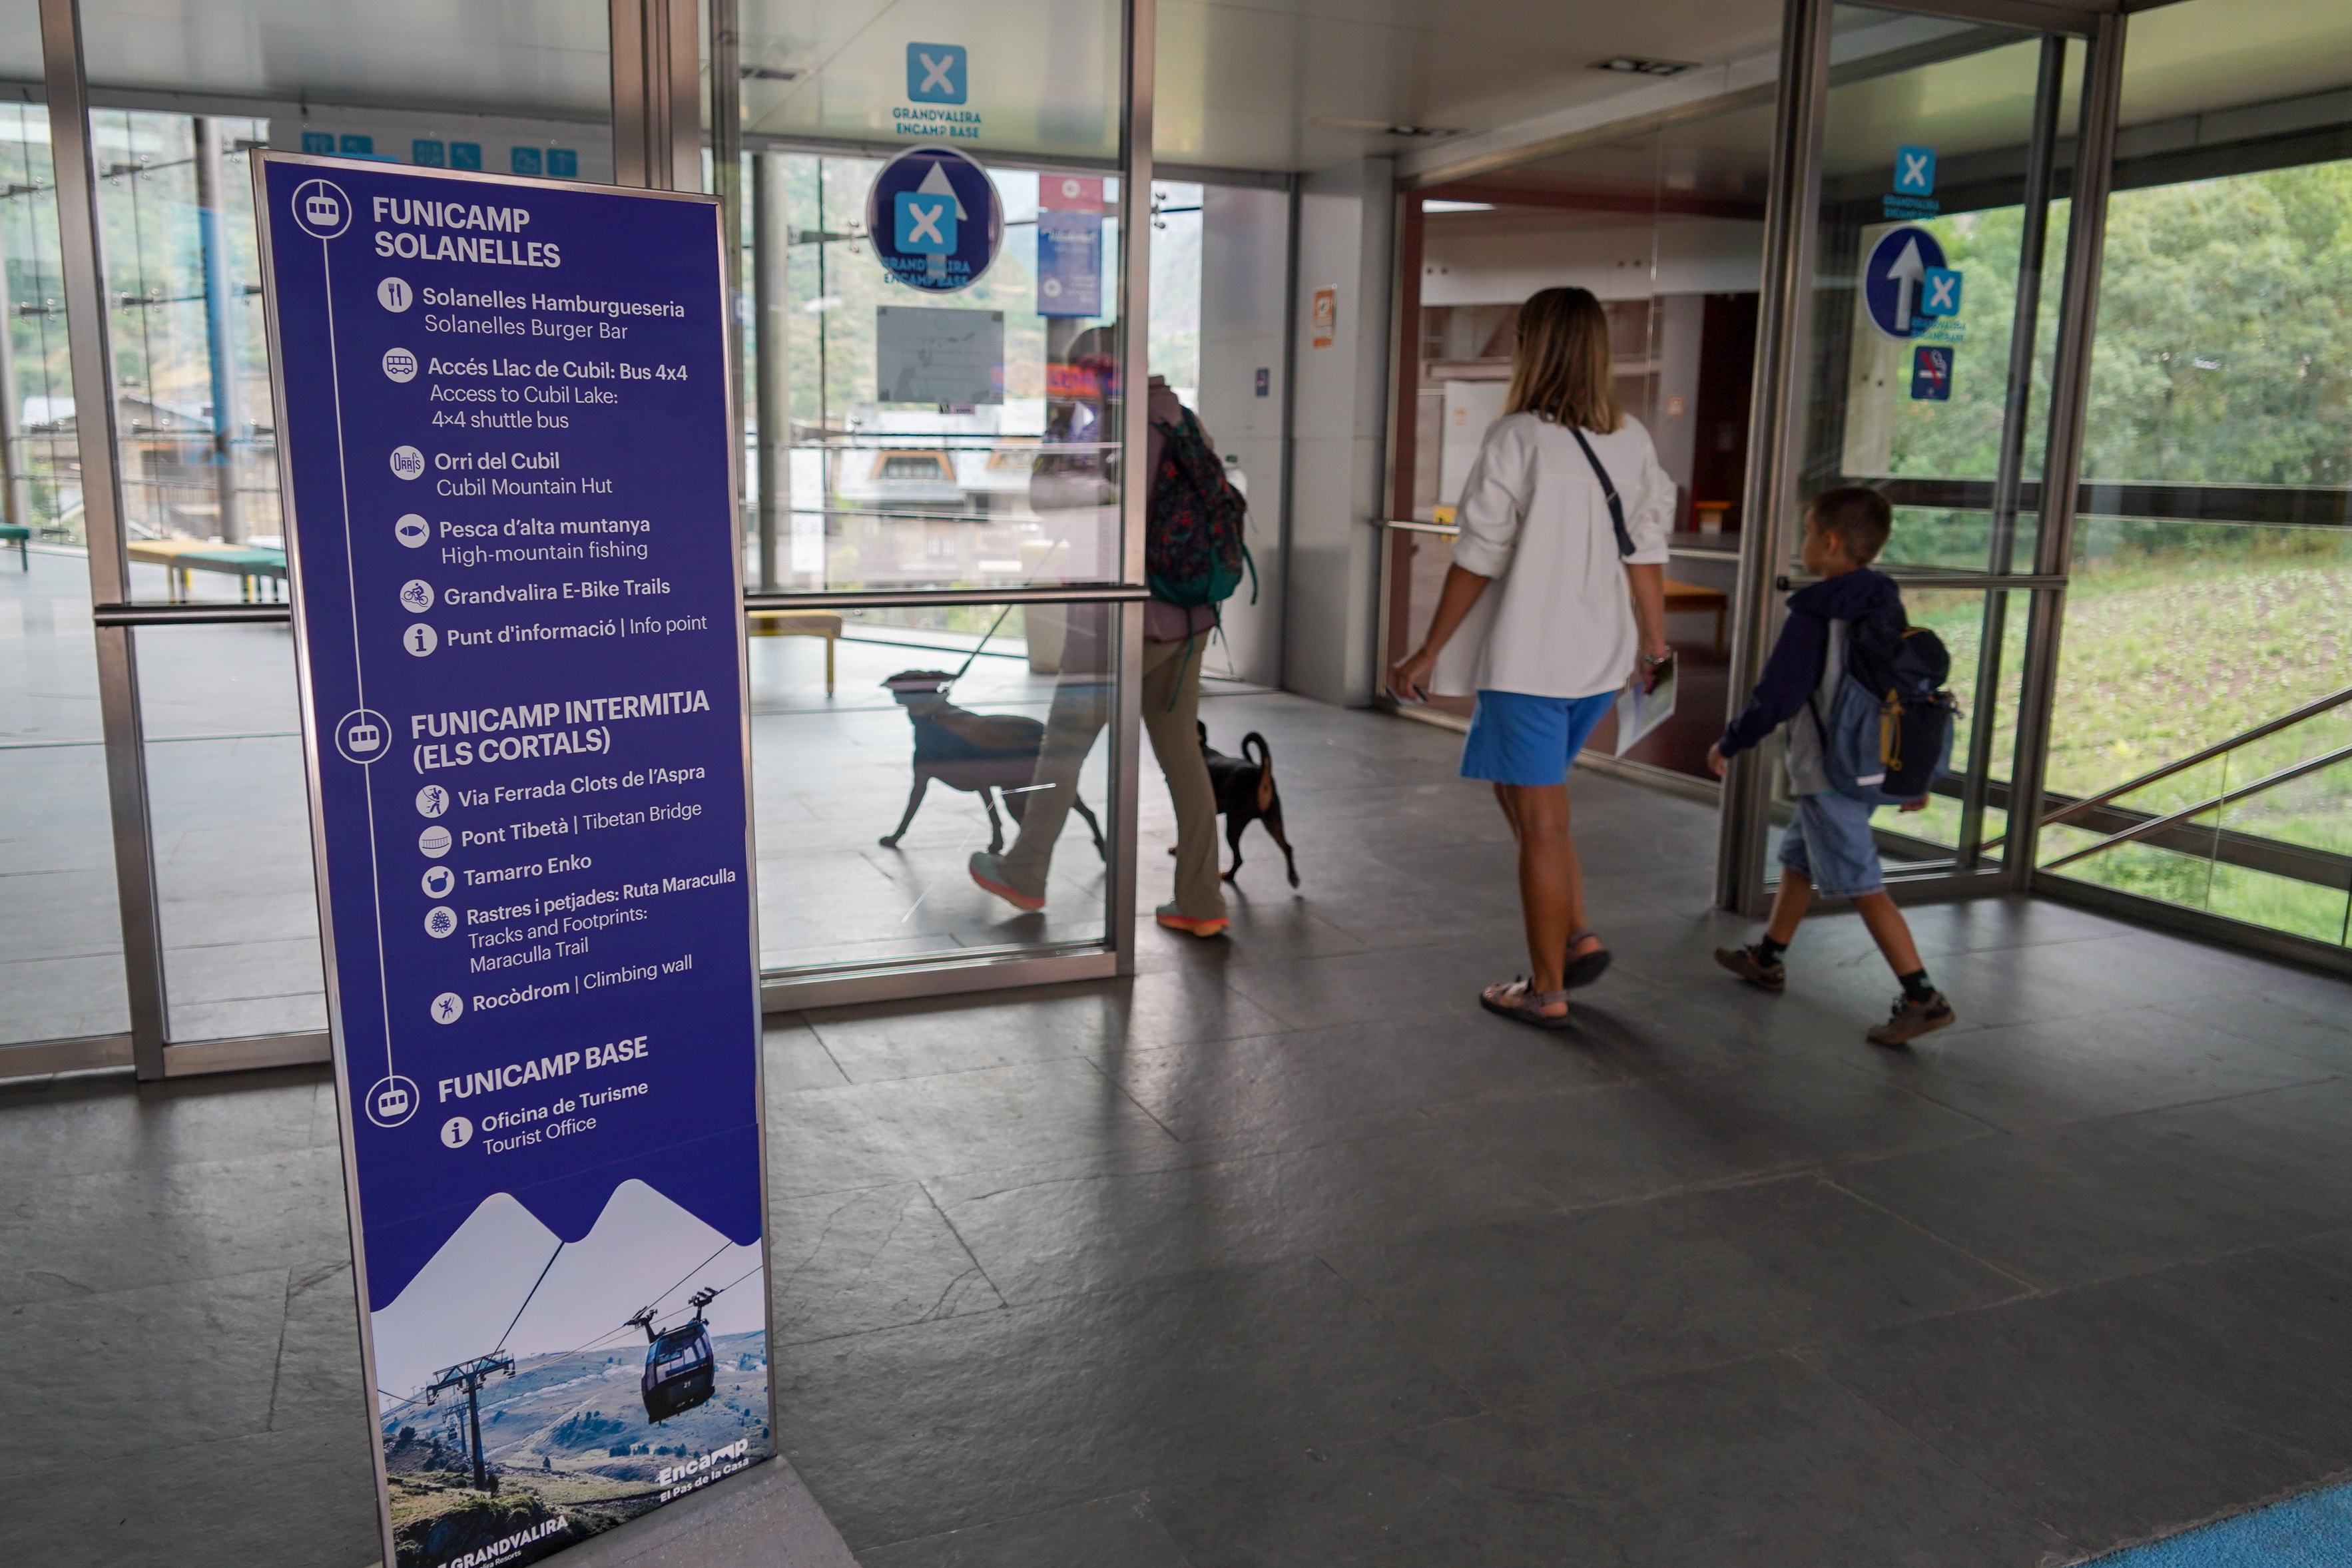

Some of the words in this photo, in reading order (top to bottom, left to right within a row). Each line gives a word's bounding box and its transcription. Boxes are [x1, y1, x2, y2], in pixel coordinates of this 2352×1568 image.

[892, 107, 982, 123] GRANDVALIRA
[896, 123, 946, 136] ENCAMP
[950, 125, 979, 138] BASE
[373, 196, 530, 233] FUNICAMP
[375, 230, 561, 268] SOLANELLES
[423, 287, 527, 310] Solanelles
[531, 293, 685, 318] Hamburgueseria
[425, 314, 525, 336] Solanelles
[531, 318, 593, 341] Burger
[599, 322, 628, 339] Bar
[428, 357, 488, 376] Accés
[492, 358, 531, 377] Llac
[535, 359, 559, 378] de
[563, 361, 615, 379] Cubil:
[619, 363, 652, 380] Bus
[655, 364, 689, 381] 4x4
[430, 384, 497, 402] Access
[500, 387, 519, 403] to
[523, 385, 570, 403] Cubil
[575, 386, 618, 404] Lake:
[471, 409, 533, 428] shuttle
[537, 410, 569, 429] bus
[434, 452, 473, 470] Orri
[477, 451, 507, 470] del
[511, 451, 560, 469] Cubil
[436, 477, 486, 497] Cubil
[491, 478, 577, 495] Mountain
[581, 477, 613, 493] Hut
[440, 521, 498, 539] Pesca
[560, 518, 651, 536] muntanya
[441, 545, 583, 567] High-mountain
[588, 540, 648, 560] fishing
[444, 583, 557, 605] Grandvalira
[563, 580, 619, 599] E-Bike
[623, 577, 671, 596] Trails
[447, 629, 493, 647] Punt
[497, 619, 616, 643] d'informació
[630, 616, 662, 635] Info
[666, 615, 708, 636] point
[411, 702, 560, 739] FUNICAMP
[565, 689, 711, 724] INTERMITJA
[413, 741, 473, 775] (ELS
[478, 726, 611, 763] CORTALS)
[457, 789, 489, 807] Via
[494, 779, 566, 804] Ferrada
[570, 776, 618, 794] Clots
[621, 770, 645, 788] de
[461, 828, 506, 847] Pont
[509, 817, 569, 840] Tibetà
[582, 811, 645, 830] Tibetan
[649, 802, 702, 822] Bridge
[463, 864, 543, 886] Tamarro
[547, 854, 592, 874] Enko
[467, 904, 532, 925] Rastres
[535, 898, 540, 914] i
[543, 888, 619, 916] petjades:
[623, 883, 659, 900] Ruta
[662, 868, 736, 894] Maraculla
[467, 927, 523, 949] Tracks
[527, 918, 559, 939] and
[563, 908, 647, 933] Footprints:
[470, 944, 551, 973] Maraculla
[555, 936, 589, 957] Trail
[473, 982, 570, 1011] Rocòdrom
[583, 965, 657, 989] Climbing
[661, 953, 692, 974] wall
[438, 1051, 581, 1103] FUNICAMP
[585, 1035, 649, 1070] BASE
[481, 1107, 548, 1132] Oficina
[553, 1098, 575, 1115] de
[579, 1083, 649, 1109] Turisme
[482, 1129, 542, 1155] Tourist
[545, 1117, 597, 1139] Office
[655, 1438, 749, 1487] Encamp
[660, 1489, 671, 1503] El
[673, 1481, 693, 1497] Pas
[694, 1475, 709, 1487] de
[711, 1470, 722, 1481] la
[723, 1457, 750, 1475] Casa
[450, 1515, 569, 1568] GRANDVALIRA
[495, 1550, 522, 1566] Resorts
